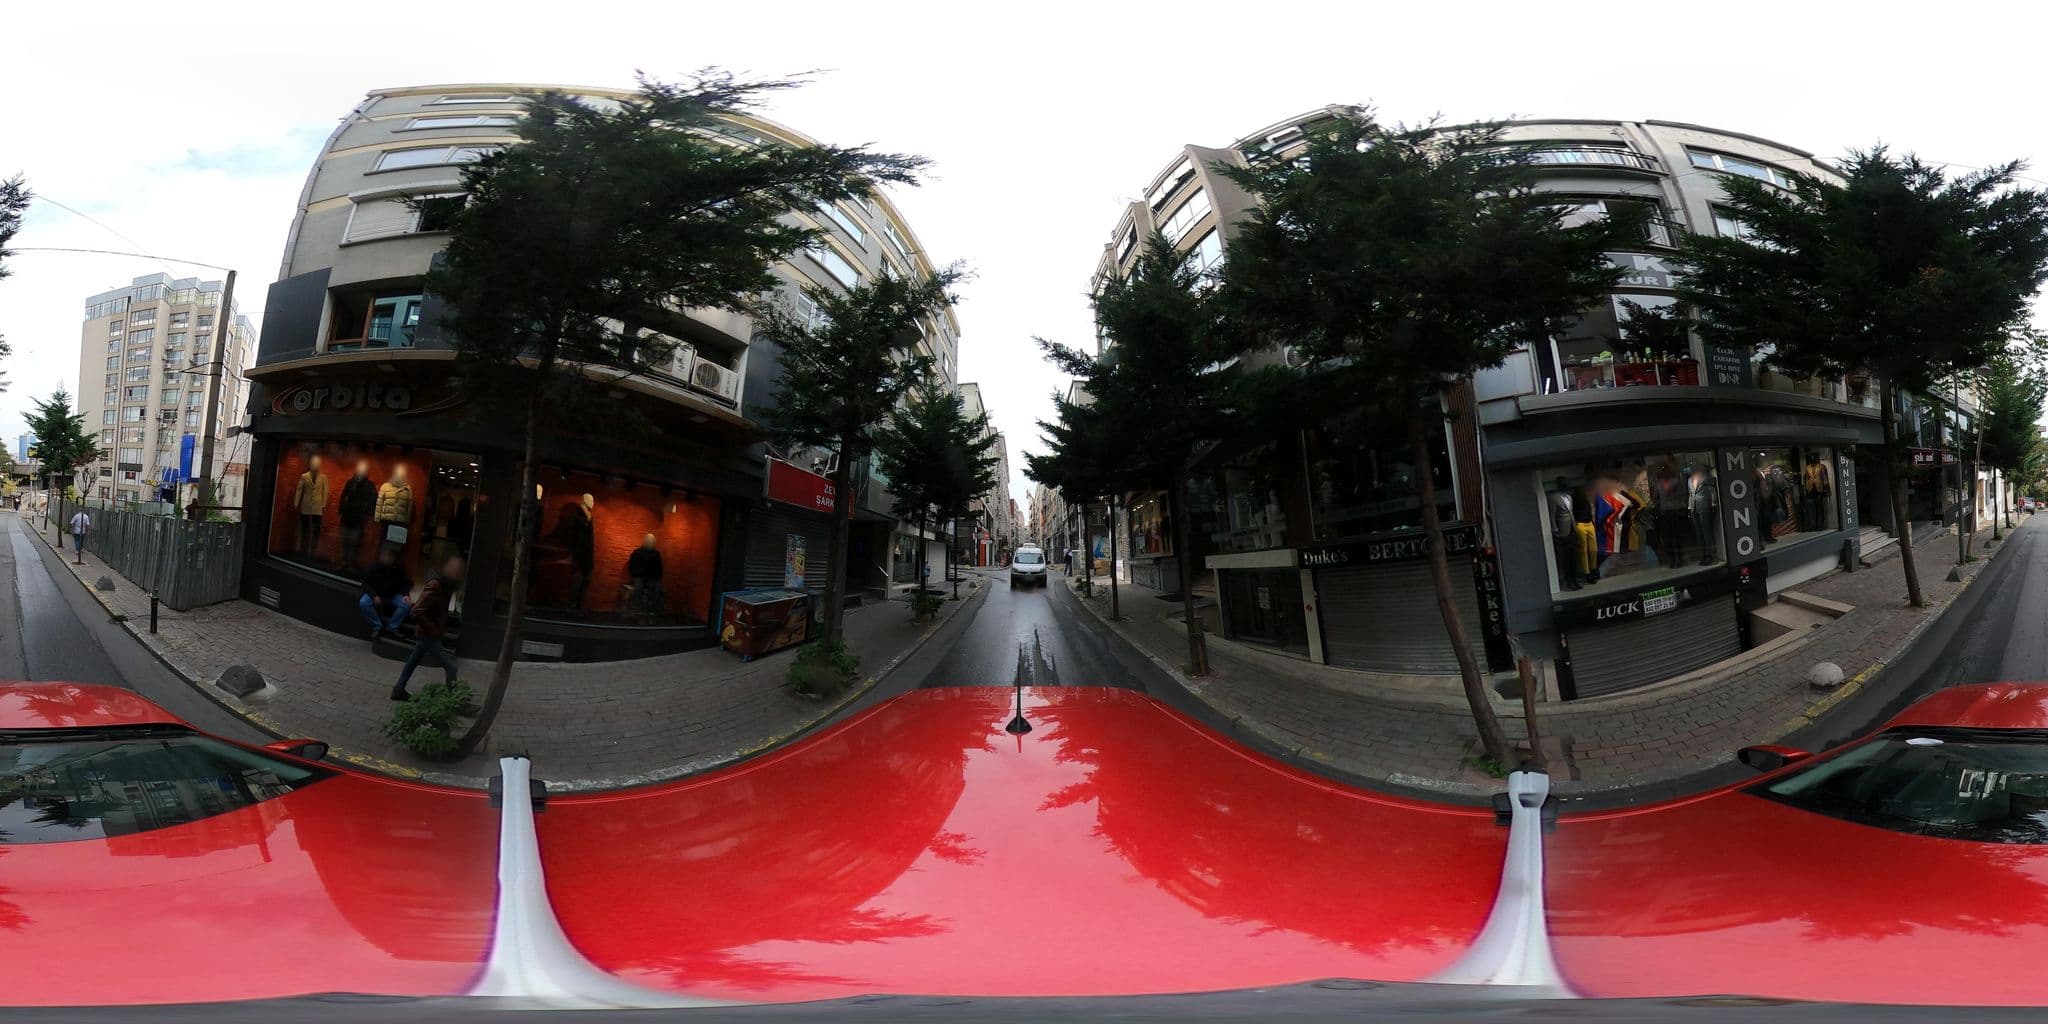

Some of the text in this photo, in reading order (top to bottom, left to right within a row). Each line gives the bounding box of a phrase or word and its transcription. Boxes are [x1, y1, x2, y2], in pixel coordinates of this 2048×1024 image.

[292, 380, 409, 412] orbita
[1840, 456, 1849, 467] By
[1726, 451, 1753, 556] MONO
[1597, 600, 1640, 620] LUCK
